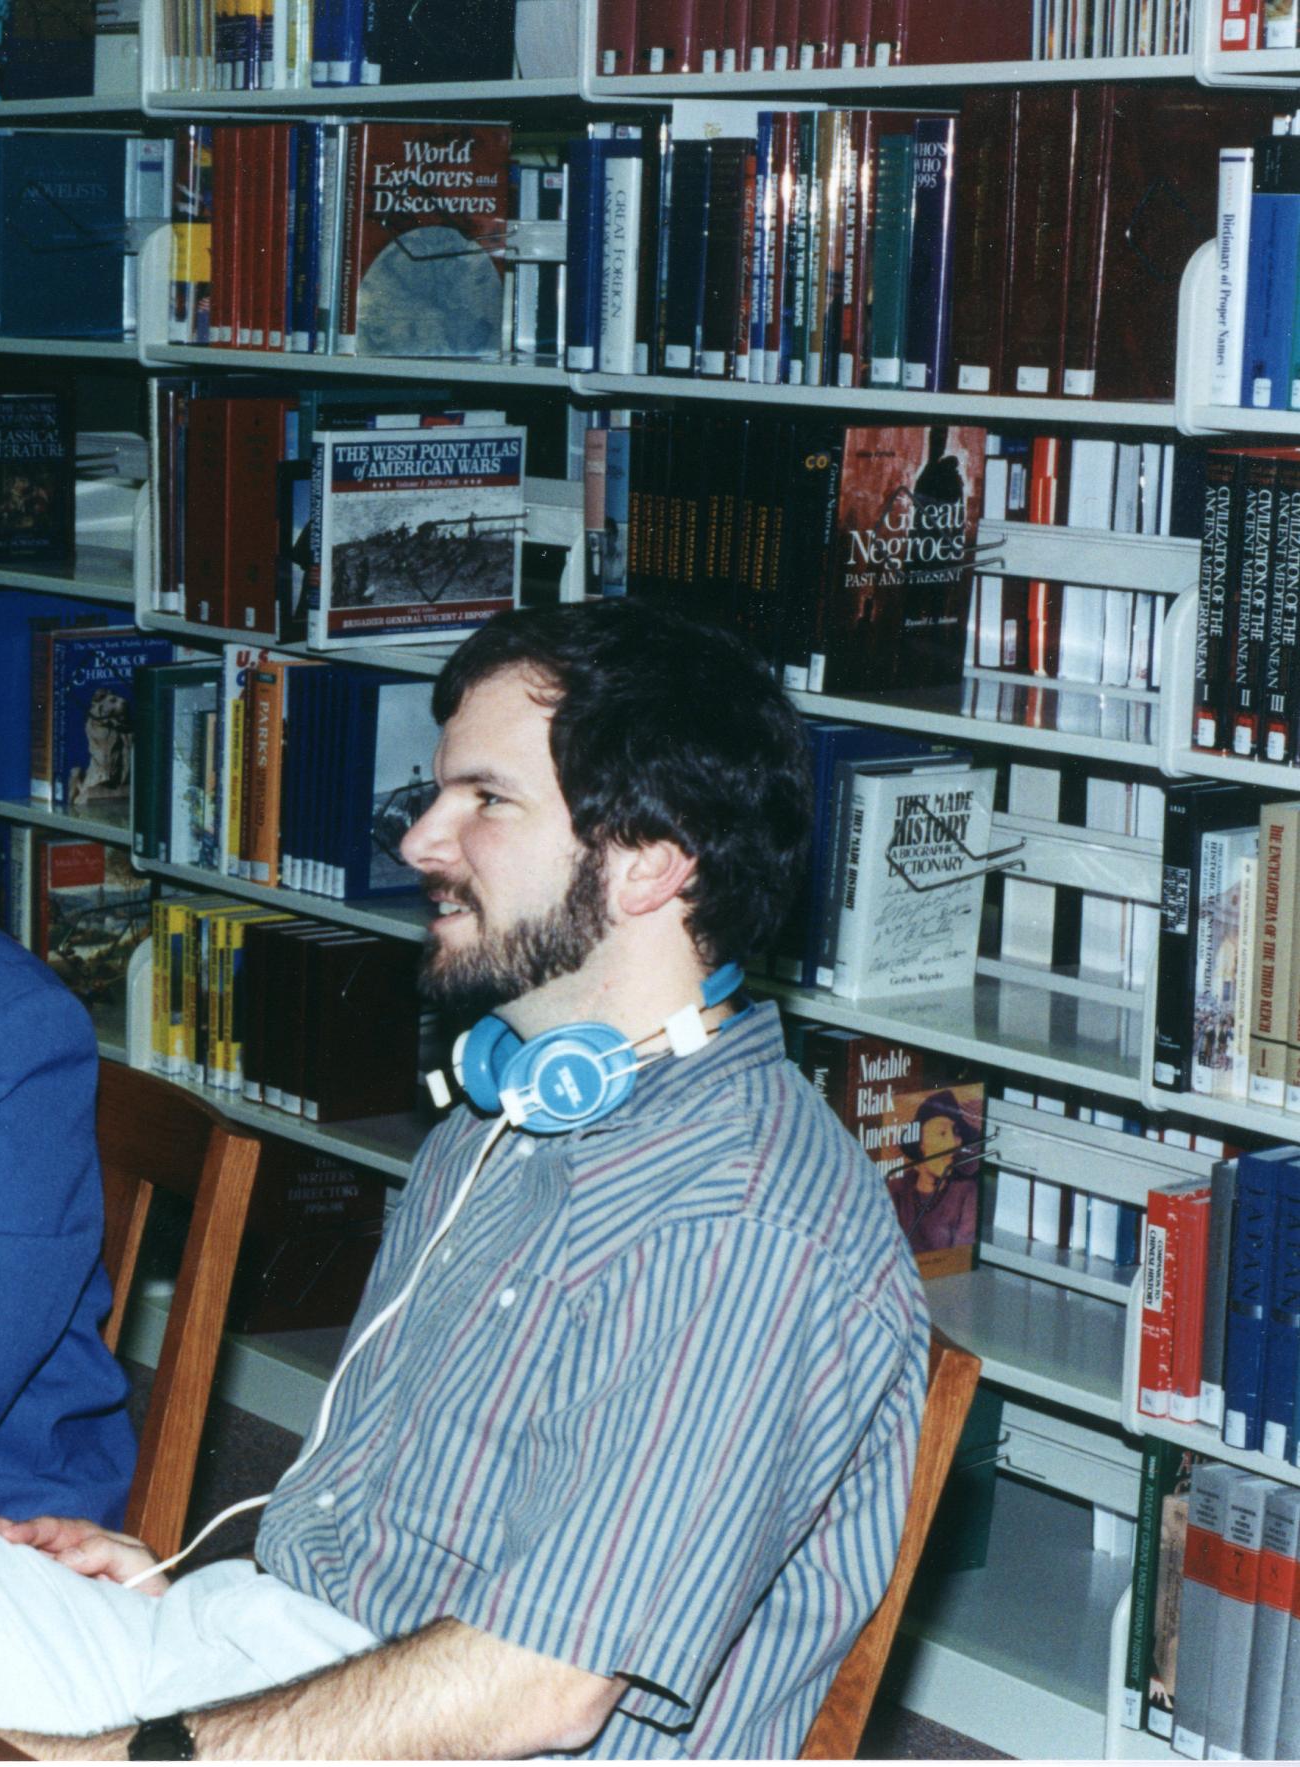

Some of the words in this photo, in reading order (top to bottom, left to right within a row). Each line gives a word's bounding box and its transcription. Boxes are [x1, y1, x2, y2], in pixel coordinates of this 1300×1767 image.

[404, 139, 475, 164] World
[373, 162, 475, 188] Explorers
[476, 173, 498, 186] and
[374, 189, 497, 213] Discoverers
[614, 190, 626, 240] GREAT
[847, 208, 856, 224] IN
[845, 228, 855, 255] THE
[1219, 213, 1235, 272] Dictionary
[611, 249, 626, 319] FOREIGN
[843, 258, 853, 305] NEWS
[1220, 274, 1231, 286] of
[1216, 289, 1231, 326] Proper
[1216, 330, 1228, 366] Names
[335, 446, 369, 462] THE
[373, 444, 418, 461] WEST
[419, 443, 467, 459] POINT
[469, 441, 519, 457] ATLAS
[353, 463, 367, 481] of
[368, 460, 454, 477] AMERICAN
[458, 458, 501, 473] WARS
[884, 497, 965, 532] Great
[1202, 486, 1216, 549] ANCIENT
[1243, 488, 1257, 554] ANCIENT
[1275, 491, 1290, 557] ANCIENT
[847, 529, 966, 570] Negroes
[1214, 486, 1230, 582] CIVILIZATION
[1254, 489, 1272, 585] CIVILIZATION
[844, 572, 875, 588] PAST
[878, 571, 905, 587] AND
[1211, 585, 1225, 604] OF
[1252, 589, 1267, 608] OF
[1284, 592, 1298, 613] OF
[1196, 555, 1213, 679] MEDITERRANEAN
[1209, 608, 1223, 637] THE
[1235, 559, 1253, 683] MEDITERRANEAN
[1250, 613, 1264, 641] THE
[1267, 561, 1285, 688] MEDITERRANEAN
[1282, 617, 1297, 645] THE
[257, 701, 270, 768] PARKS
[934, 791, 974, 813] MADE
[893, 814, 971, 847] HISTORY
[1270, 825, 1284, 843] THE
[899, 844, 965, 859] BIOGRAPHIC
[1264, 846, 1282, 921] ENCYCLOPEDIA
[1263, 924, 1277, 937] OF
[1262, 941, 1276, 961] THE
[1260, 965, 1274, 997] THIRD
[1258, 1000, 1273, 1033] REICH
[859, 1049, 912, 1084] Notable
[857, 1084, 895, 1118] Black
[859, 1118, 921, 1151] American
[1148, 1230, 1156, 1266] CHINESE
[1243, 1186, 1267, 1299] JAPAN
[1234, 1550, 1245, 1575] 7
